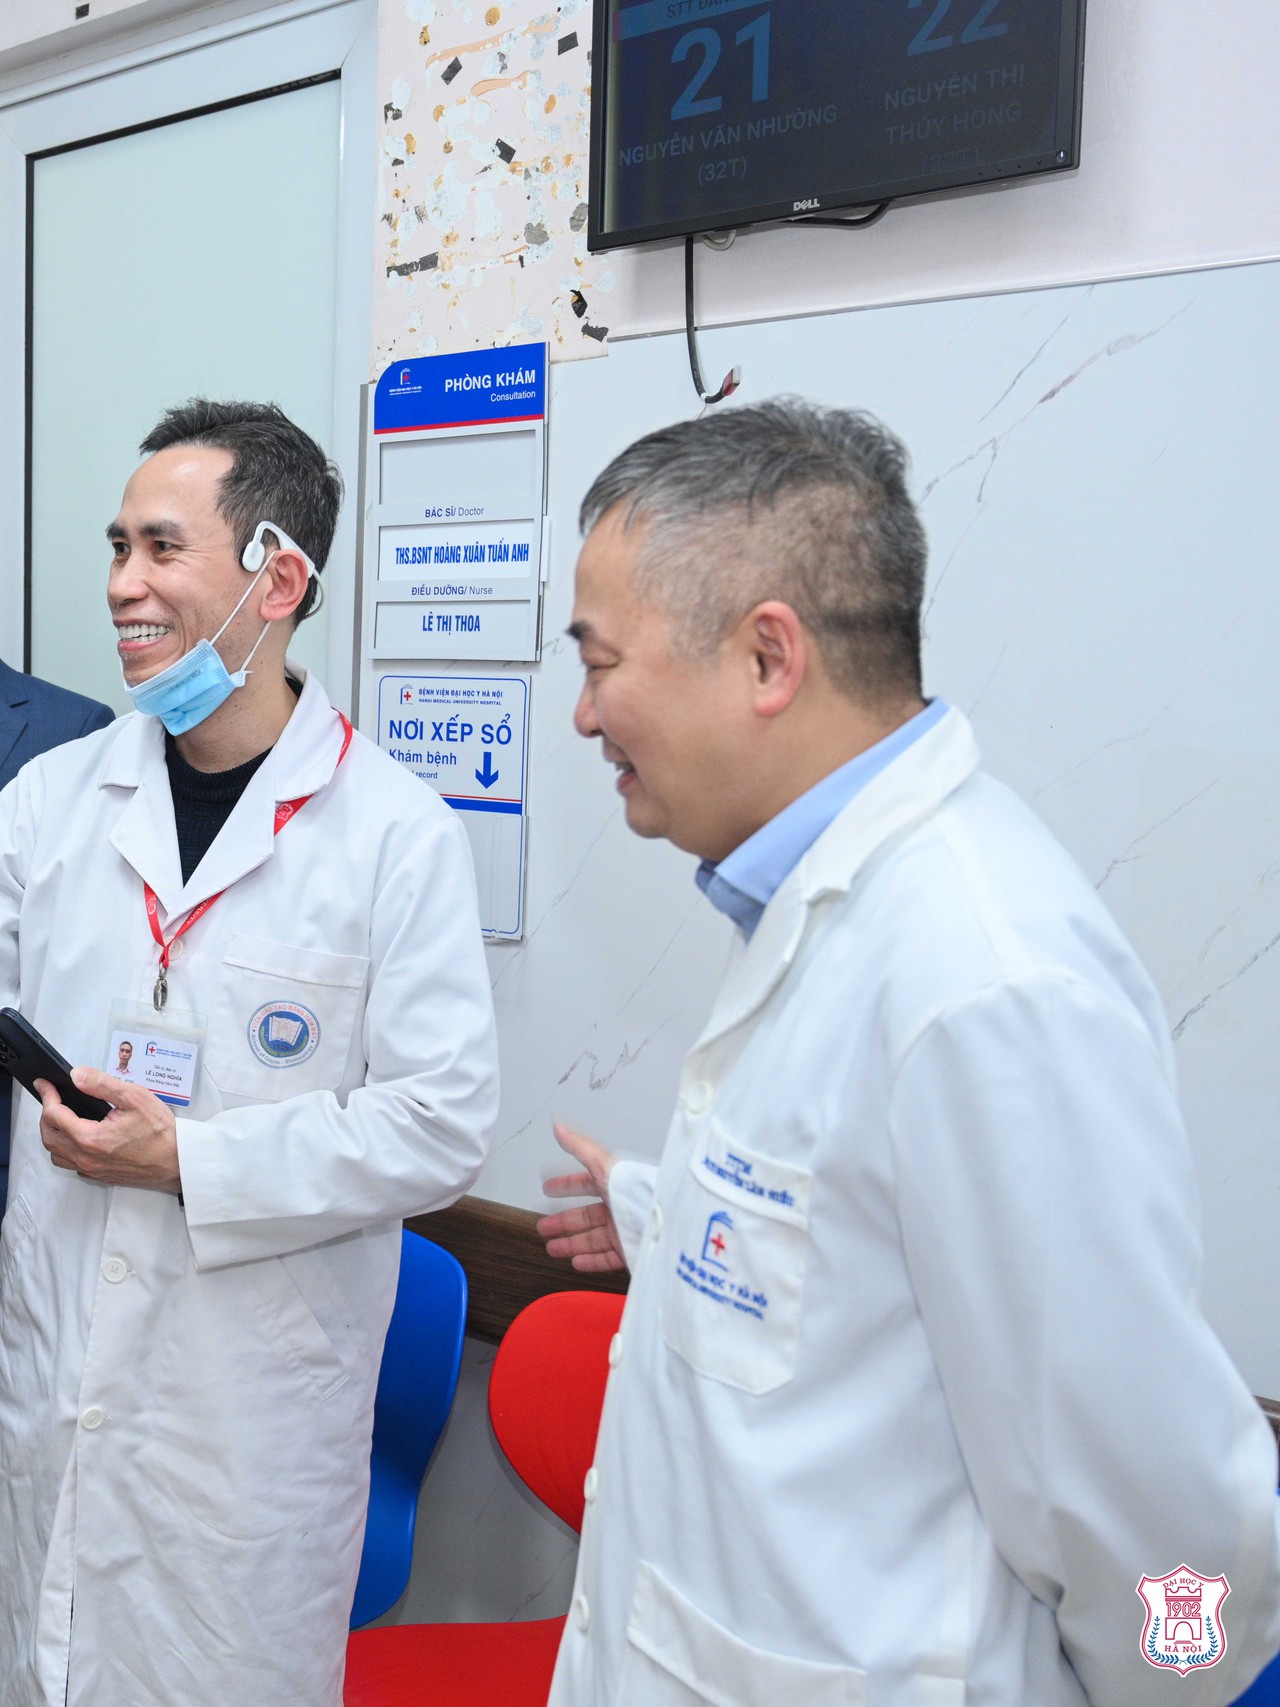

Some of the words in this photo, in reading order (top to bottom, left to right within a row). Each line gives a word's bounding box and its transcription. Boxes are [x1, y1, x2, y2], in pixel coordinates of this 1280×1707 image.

[906, 0, 1010, 57] 22
[669, 12, 771, 121] 21
[619, 131, 694, 167] NGUYỄN
[700, 126, 741, 150] VĂN
[747, 104, 838, 140] NHƯỜNG
[697, 155, 748, 186] (32T)
[793, 198, 820, 212] DELL
[444, 373, 492, 393] PHÒNG
[495, 367, 537, 388] KHÁM
[490, 390, 536, 402] Consultation
[425, 506, 443, 518] BÁC
[458, 506, 484, 517] Doctor
[395, 546, 433, 565] THS.BSNT
[433, 542, 461, 564] HOÀNG
[462, 541, 486, 563] XUÂN
[487, 537, 509, 562] TUẤN
[510, 543, 530, 562] ANH
[469, 586, 493, 595] Nurse
[422, 611, 433, 632] LÊ
[436, 614, 452, 636] THỊ
[455, 614, 481, 632] THOA
[418, 687, 434, 697] BỆNH
[436, 687, 450, 698] VIỆN
[462, 689, 475, 699] HỌC
[482, 688, 491, 698] HÀ
[491, 689, 503, 699] NỘI
[389, 718, 424, 741] NƠI
[431, 714, 473, 743] XẾP
[480, 713, 512, 746] SỔ
[389, 749, 423, 764] Khám
[427, 750, 457, 767] bệnh
[416, 771, 438, 779] record
[152, 1071, 167, 1079] LONG
